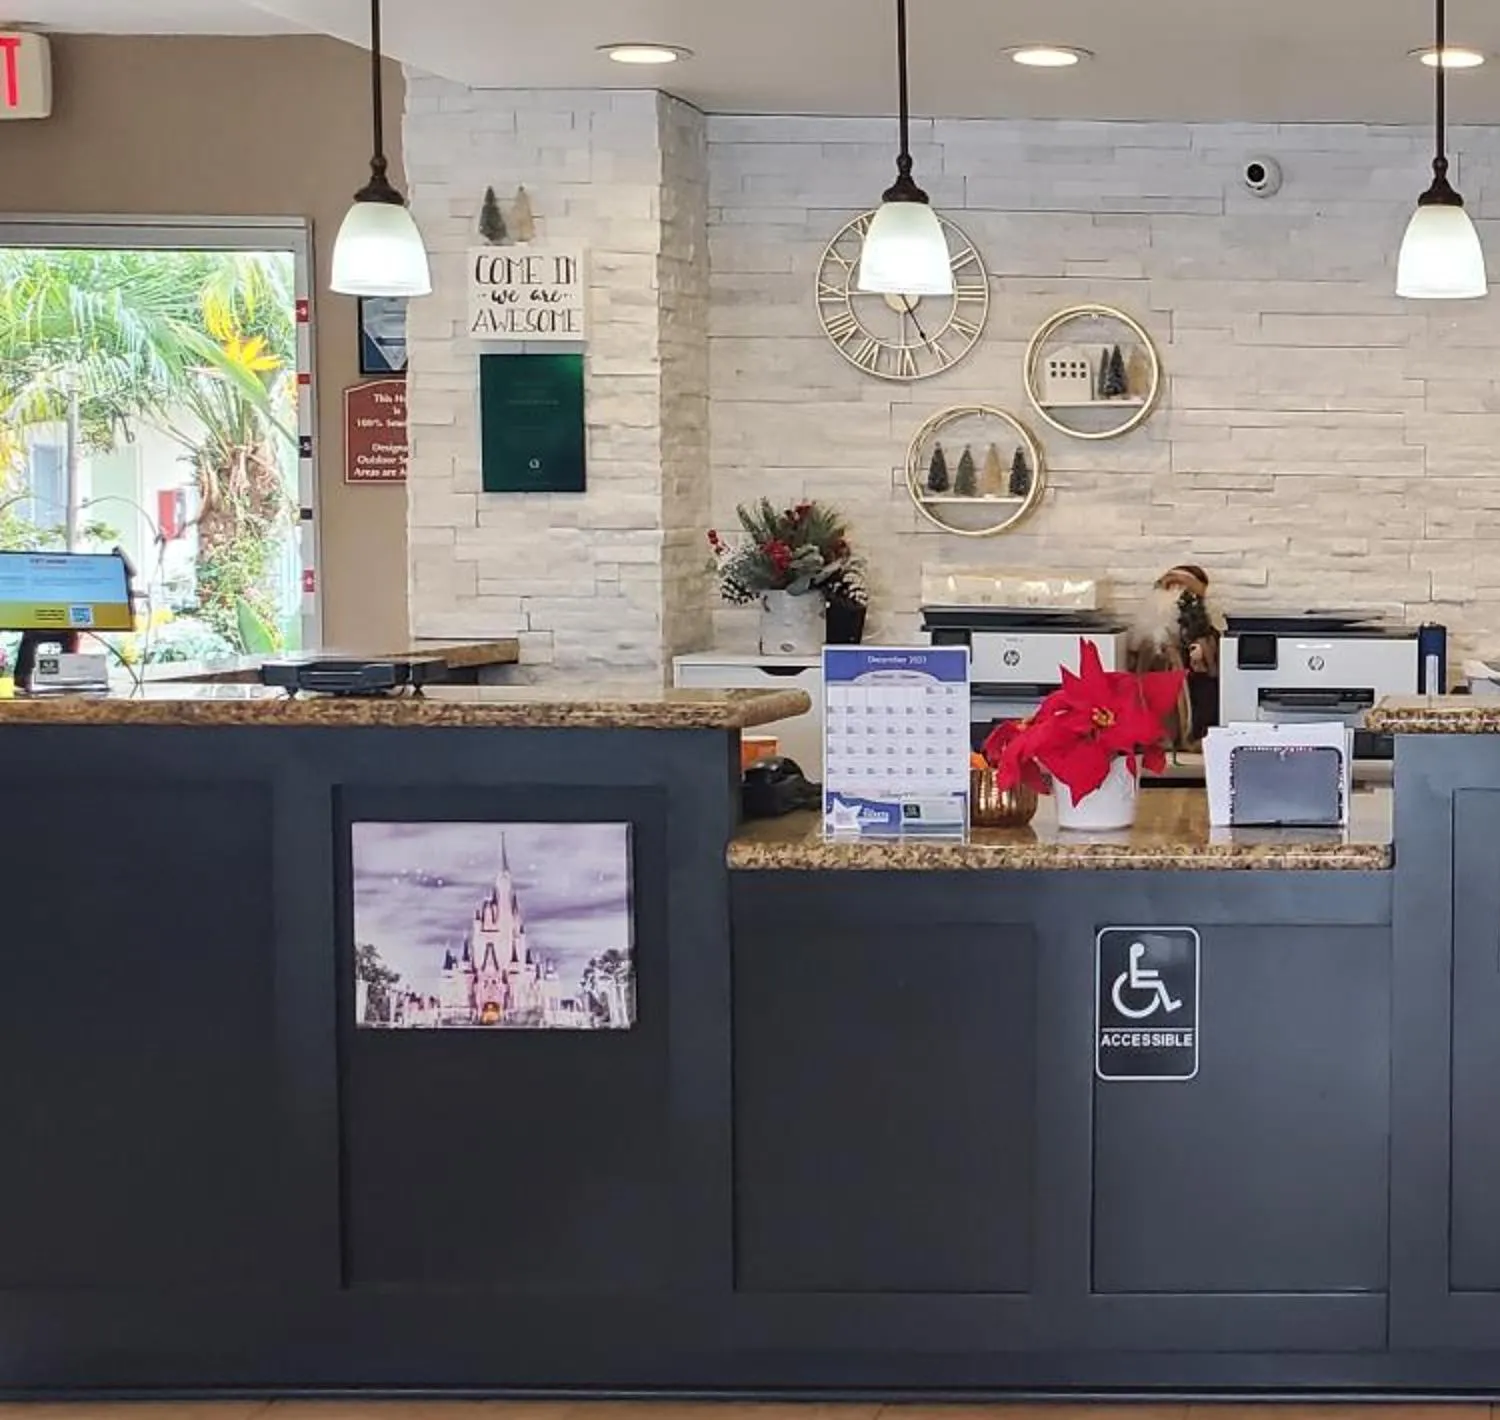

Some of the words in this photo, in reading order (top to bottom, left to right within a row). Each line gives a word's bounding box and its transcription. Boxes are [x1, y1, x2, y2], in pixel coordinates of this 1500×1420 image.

[475, 255, 543, 285] COME
[551, 255, 576, 285] IN
[491, 289, 519, 304] we
[530, 289, 561, 302] are
[471, 308, 581, 333] AWESOME
[373, 393, 392, 403] This
[357, 455, 396, 465] Outdoor
[354, 467, 380, 477] Areas
[382, 468, 397, 477] are
[867, 655, 907, 664] December
[1101, 1033, 1193, 1047] ACCESSIBLE
